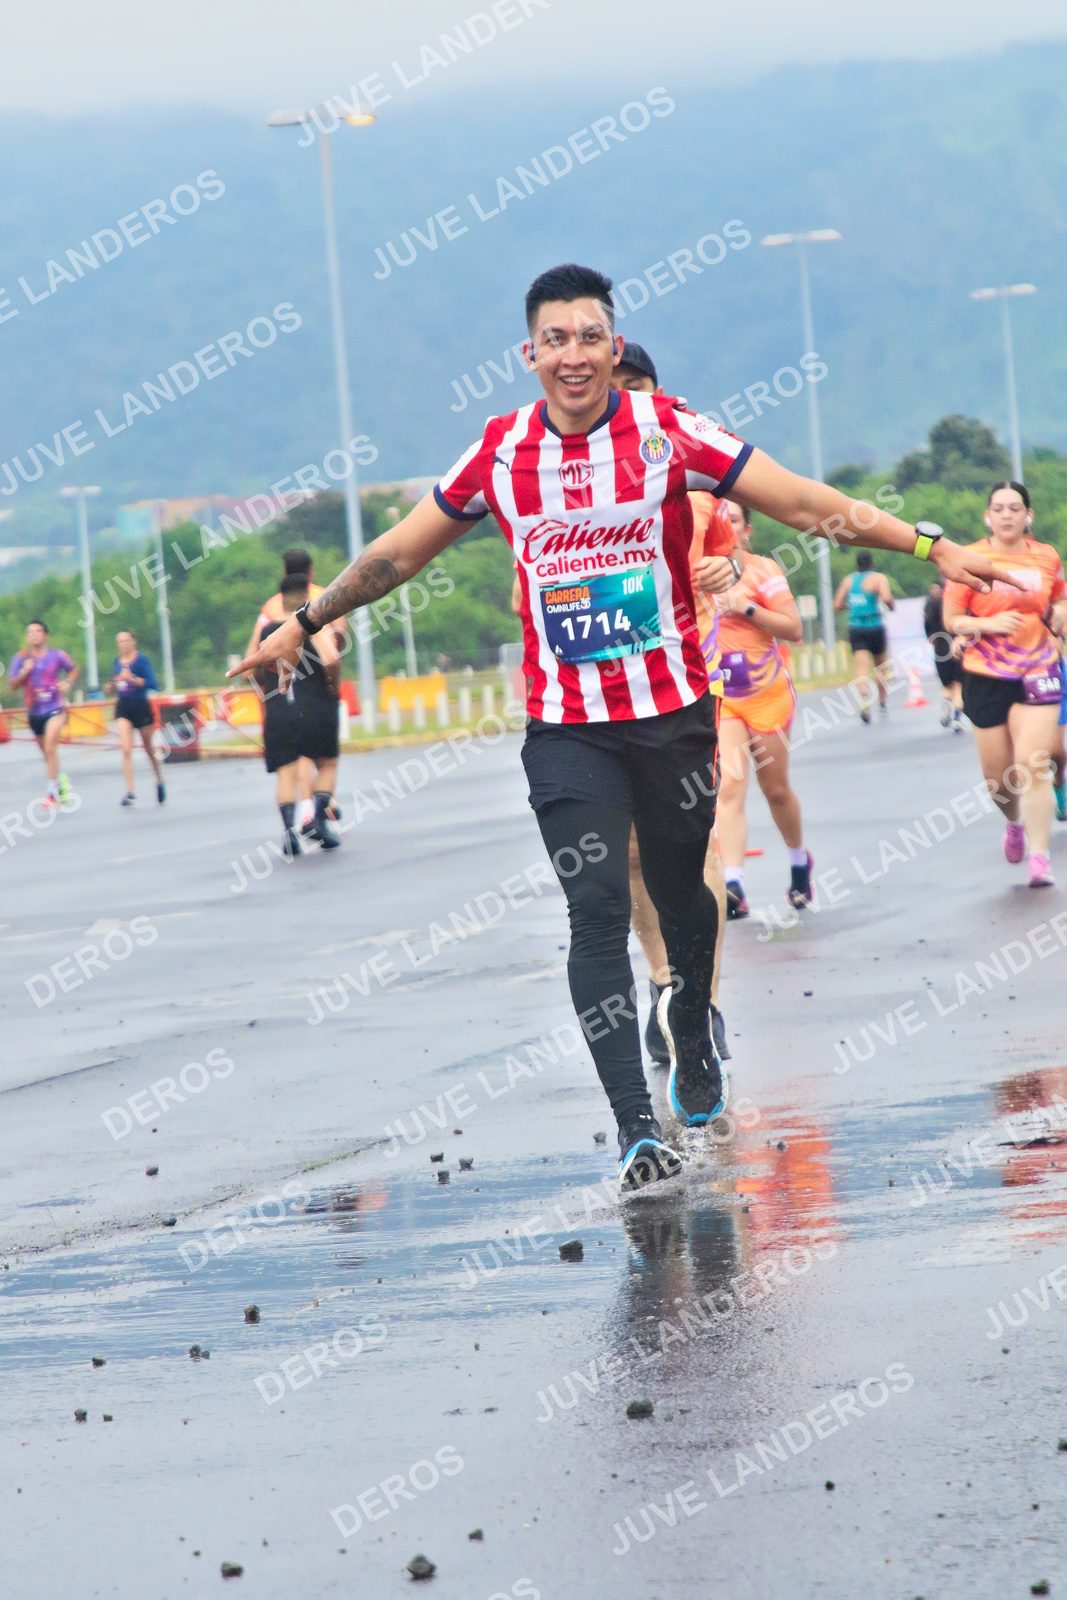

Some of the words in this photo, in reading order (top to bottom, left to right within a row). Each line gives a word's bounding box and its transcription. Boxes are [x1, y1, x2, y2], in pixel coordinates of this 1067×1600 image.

[560, 462, 592, 486] MG
[521, 517, 654, 564] Caliente
[536, 546, 658, 578] caliente.mx
[545, 586, 590, 605] CARRERA
[621, 576, 644, 595] 10K
[561, 608, 631, 641] 1714
